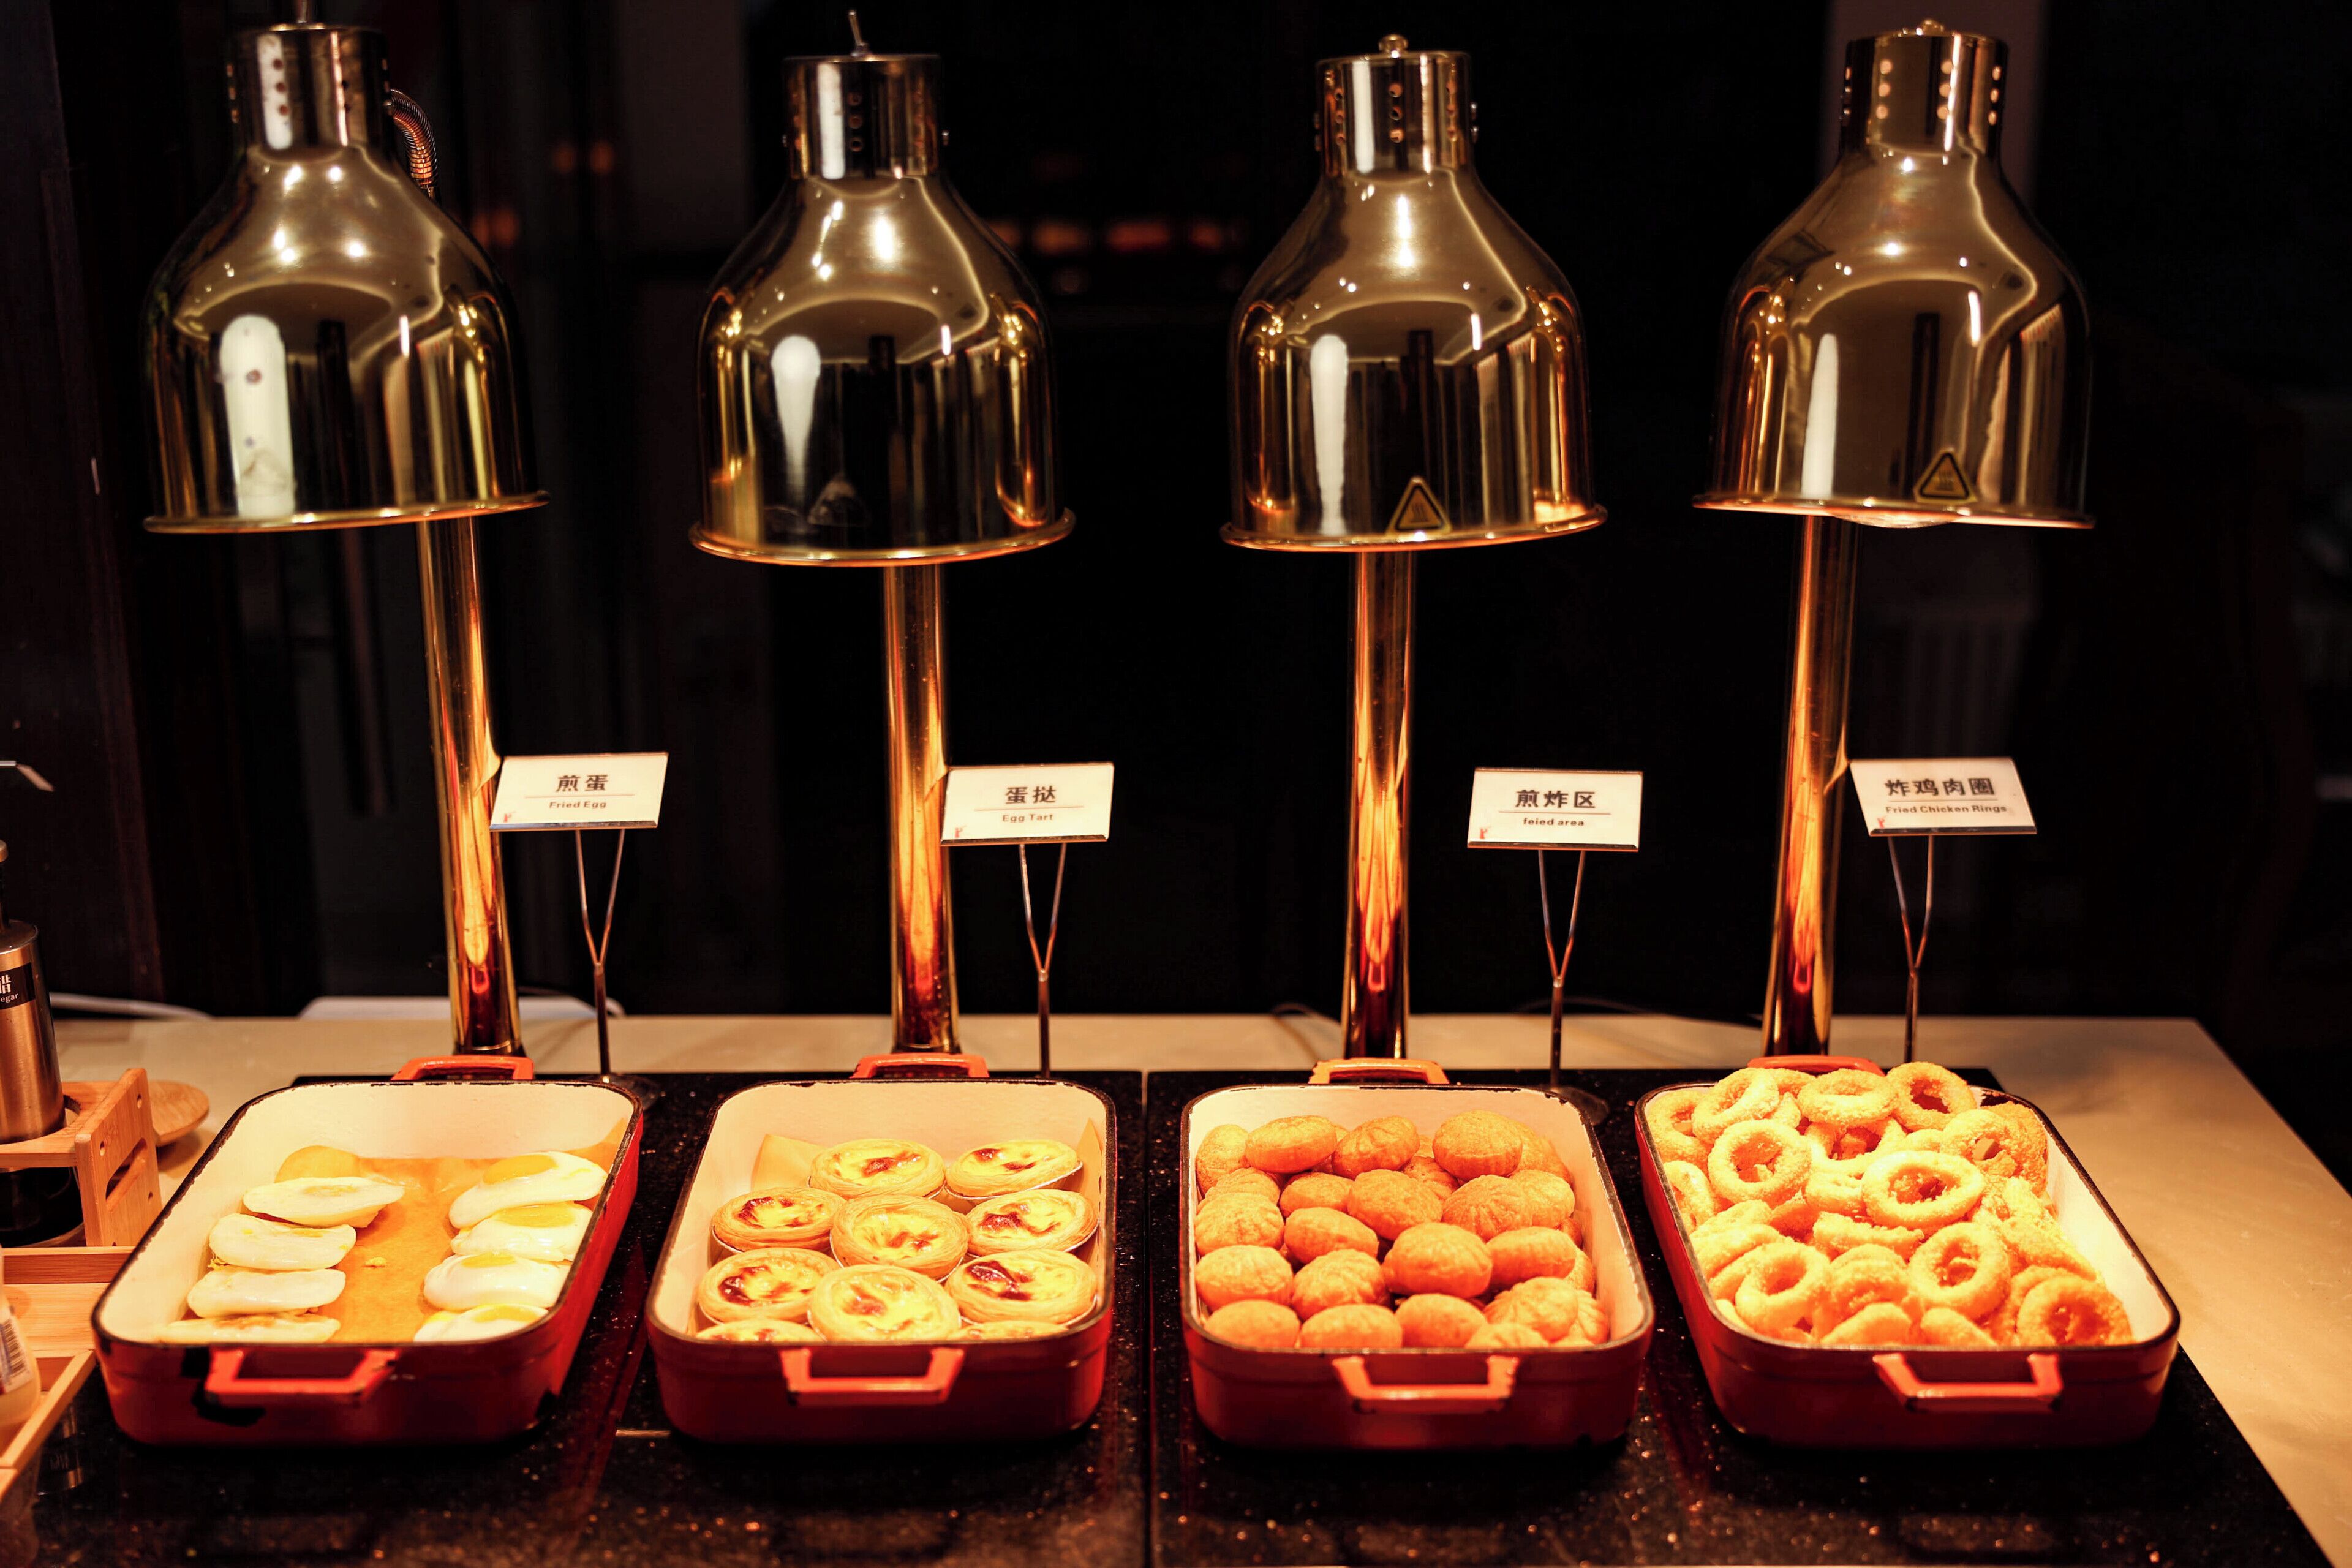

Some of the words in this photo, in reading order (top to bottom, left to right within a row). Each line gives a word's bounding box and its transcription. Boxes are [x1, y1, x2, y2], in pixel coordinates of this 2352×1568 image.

[556, 774, 608, 792] 煎蛋
[1884, 778, 1995, 796] 炸鸡肉圈
[1005, 785, 1057, 804] 蛋挞
[1515, 790, 1596, 809] 煎炸区
[583, 801, 607, 809] Egg
[1973, 805, 2007, 813] Rings
[1002, 814, 1025, 823] Egg
